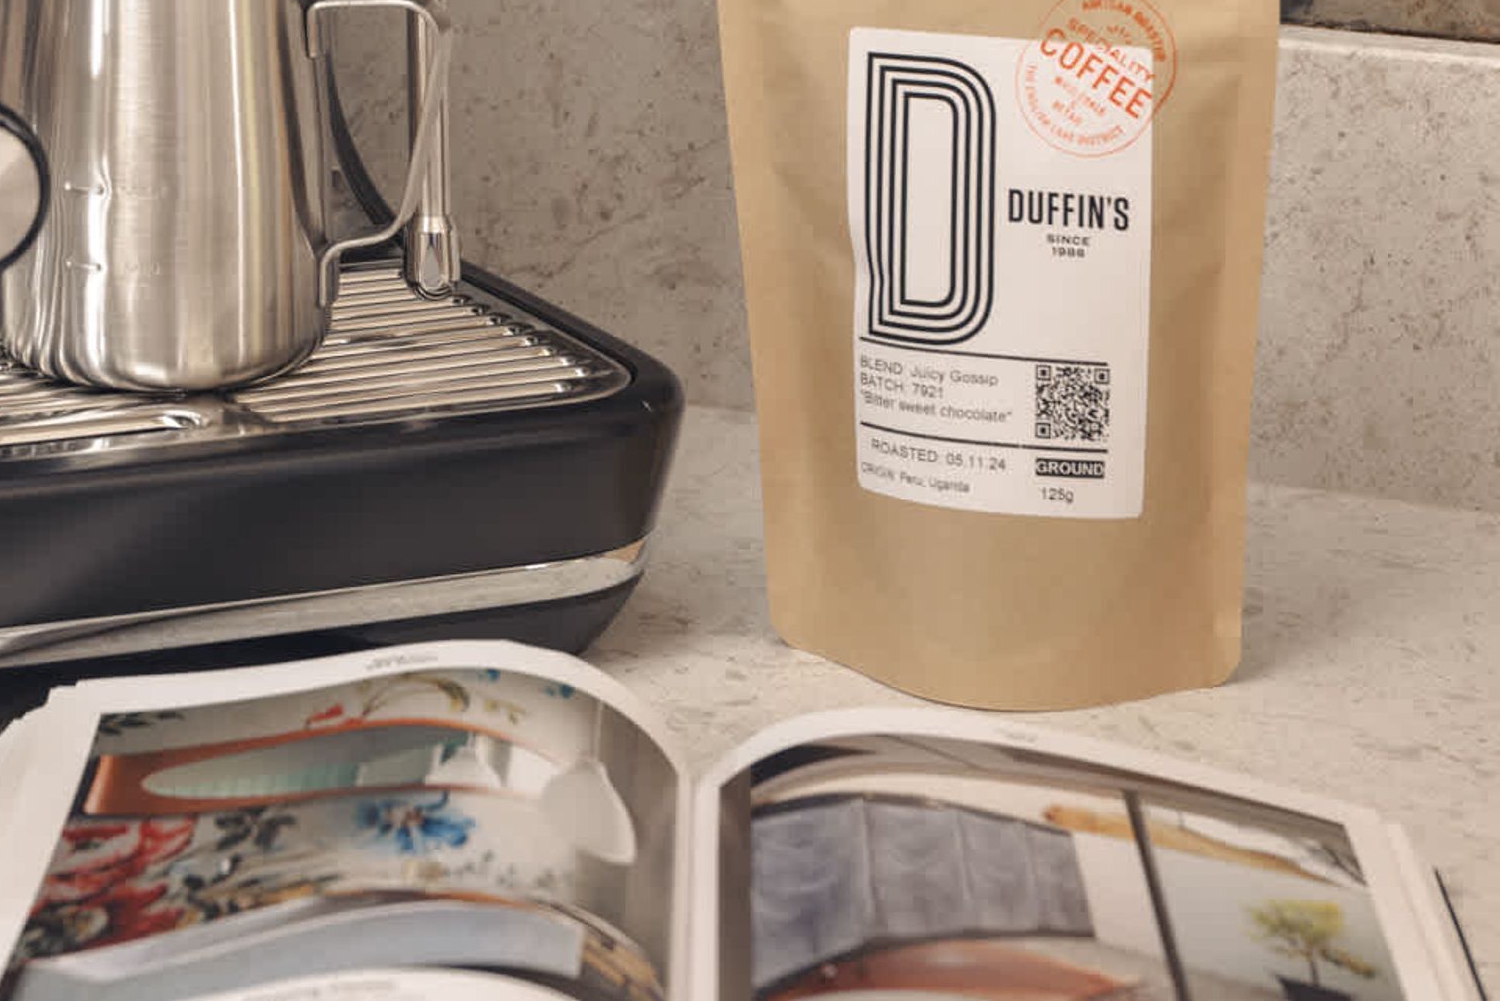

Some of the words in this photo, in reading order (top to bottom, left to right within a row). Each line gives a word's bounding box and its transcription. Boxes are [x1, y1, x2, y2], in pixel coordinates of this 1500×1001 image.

[1040, 27, 1152, 119] COFFEE
[1008, 188, 1130, 232] DUFFIN'S
[1046, 233, 1092, 247] SINCE
[950, 370, 999, 387] Gossip
[912, 383, 944, 399] 7921
[900, 401, 936, 416] sweet
[1037, 460, 1104, 476] GROUND
[1041, 486, 1074, 505] 125g
